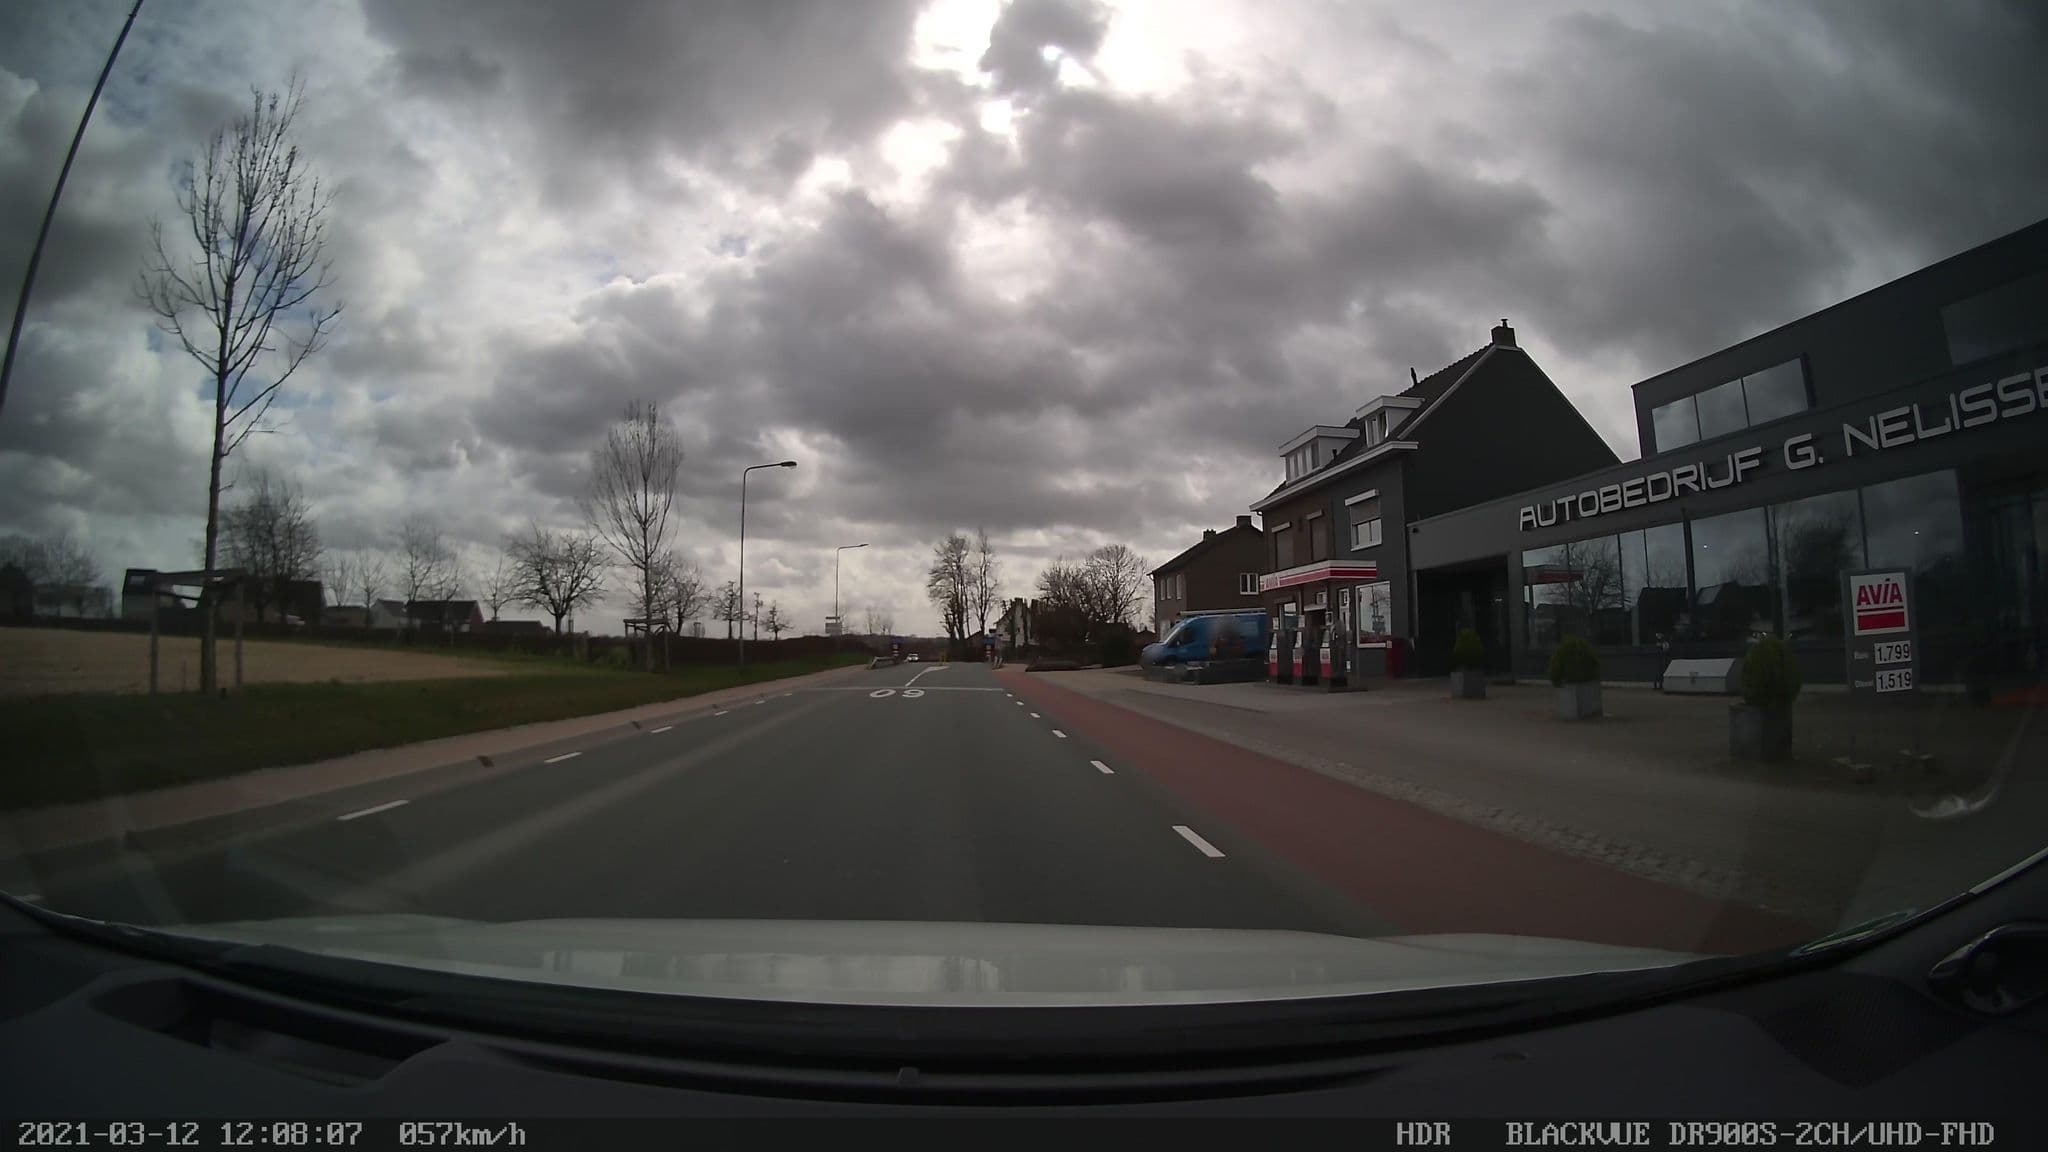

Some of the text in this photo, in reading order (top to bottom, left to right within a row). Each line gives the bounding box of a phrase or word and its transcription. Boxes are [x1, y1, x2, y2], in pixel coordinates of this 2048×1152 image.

[1518, 446, 1762, 532] AUTOBEDRIJF
[1783, 433, 1824, 471] G.
[1876, 643, 1911, 662] 1.799
[1878, 671, 1912, 690] 1.519
